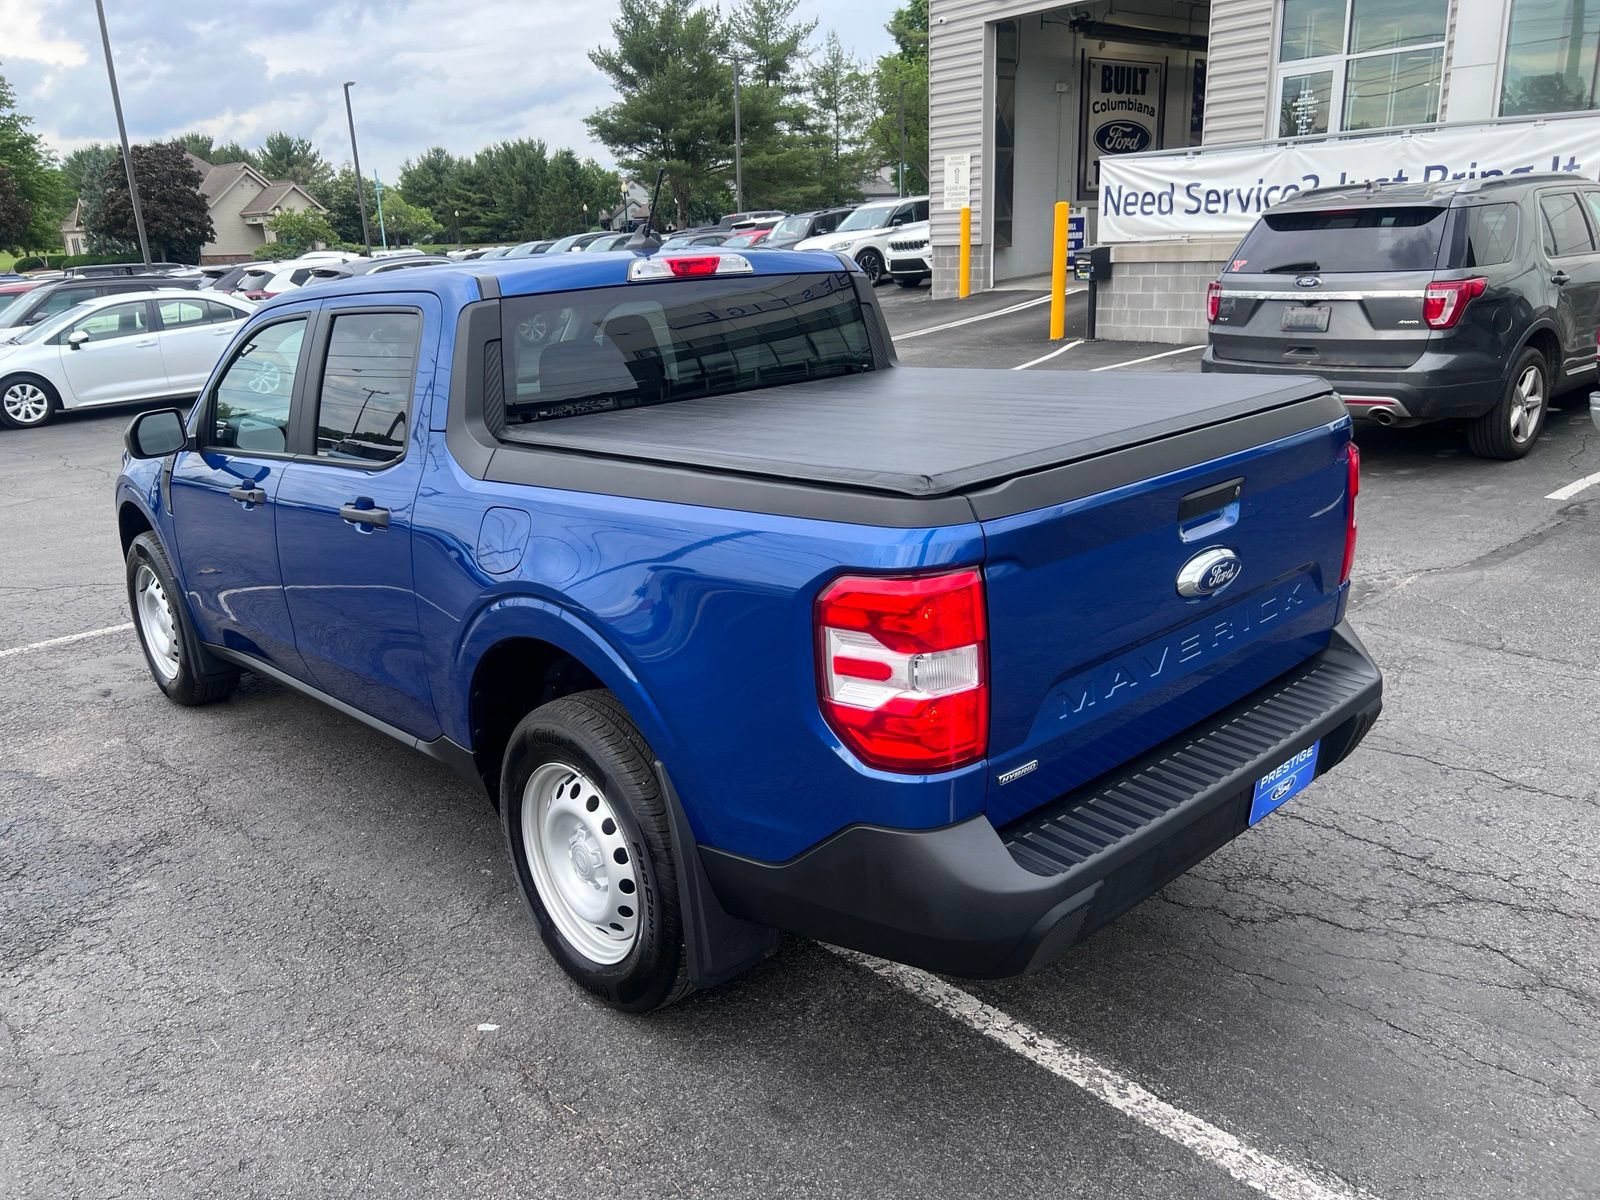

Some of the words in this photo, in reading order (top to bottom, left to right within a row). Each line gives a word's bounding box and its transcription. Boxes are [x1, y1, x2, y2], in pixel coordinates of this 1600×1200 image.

[1101, 65, 1150, 95] BUILT
[1092, 98, 1155, 117] Columbiana
[1105, 125, 1140, 150] Ford
[1103, 182, 1175, 217] Need
[1208, 561, 1234, 588] Ford
[1056, 583, 1303, 719] MAVERICK
[1001, 763, 1037, 783] HYBRID
[1260, 745, 1314, 789] PRESTIGE
